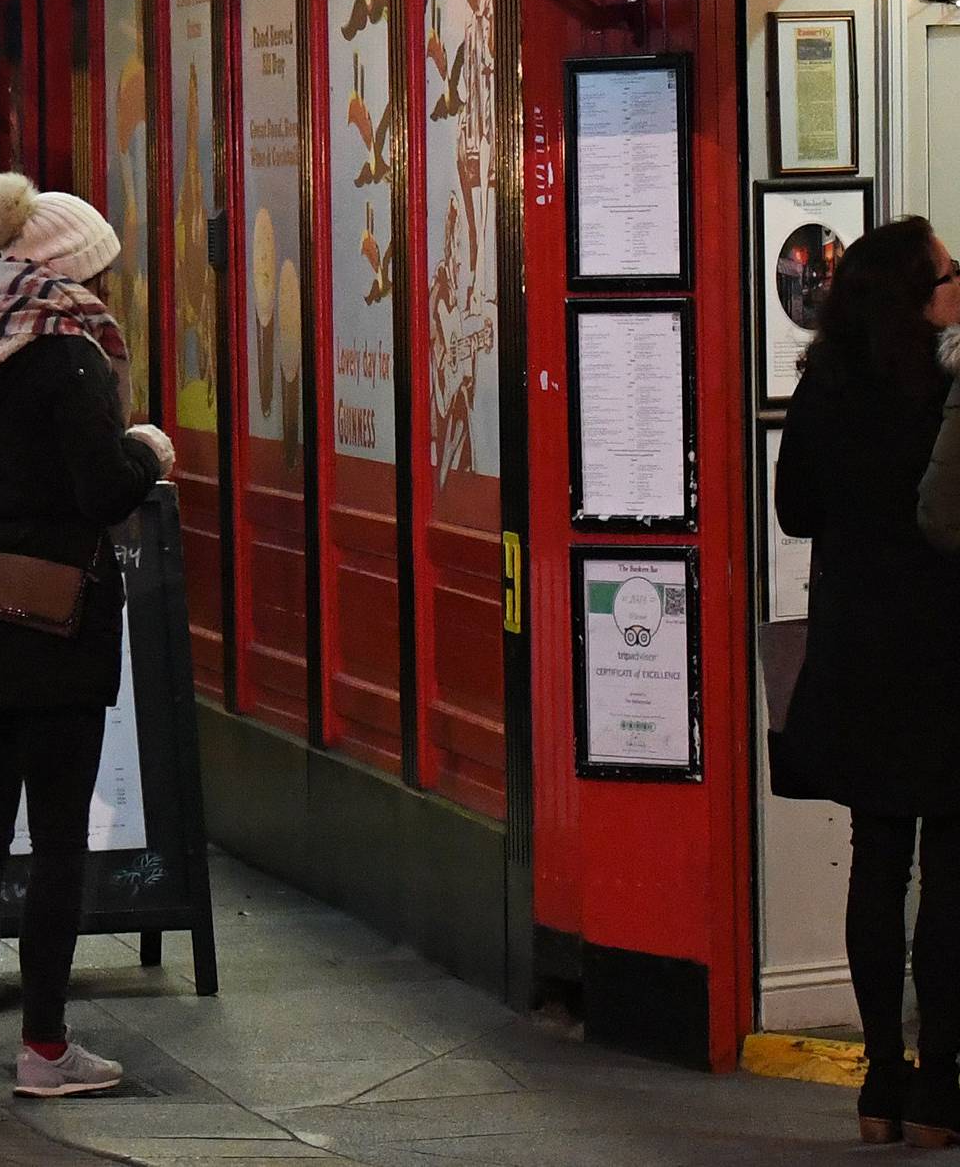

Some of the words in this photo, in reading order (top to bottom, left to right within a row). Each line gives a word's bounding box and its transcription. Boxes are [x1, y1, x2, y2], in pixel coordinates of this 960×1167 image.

[363, 338, 376, 389] day
[378, 339, 391, 381] for
[337, 398, 376, 449] GUINNESS
[618, 564, 628, 572] The
[629, 565, 649, 573] Bankers
[650, 565, 659, 573] Bar
[596, 667, 632, 678] CERTIFICATE
[642, 670, 681, 680] EXCELLENCE
